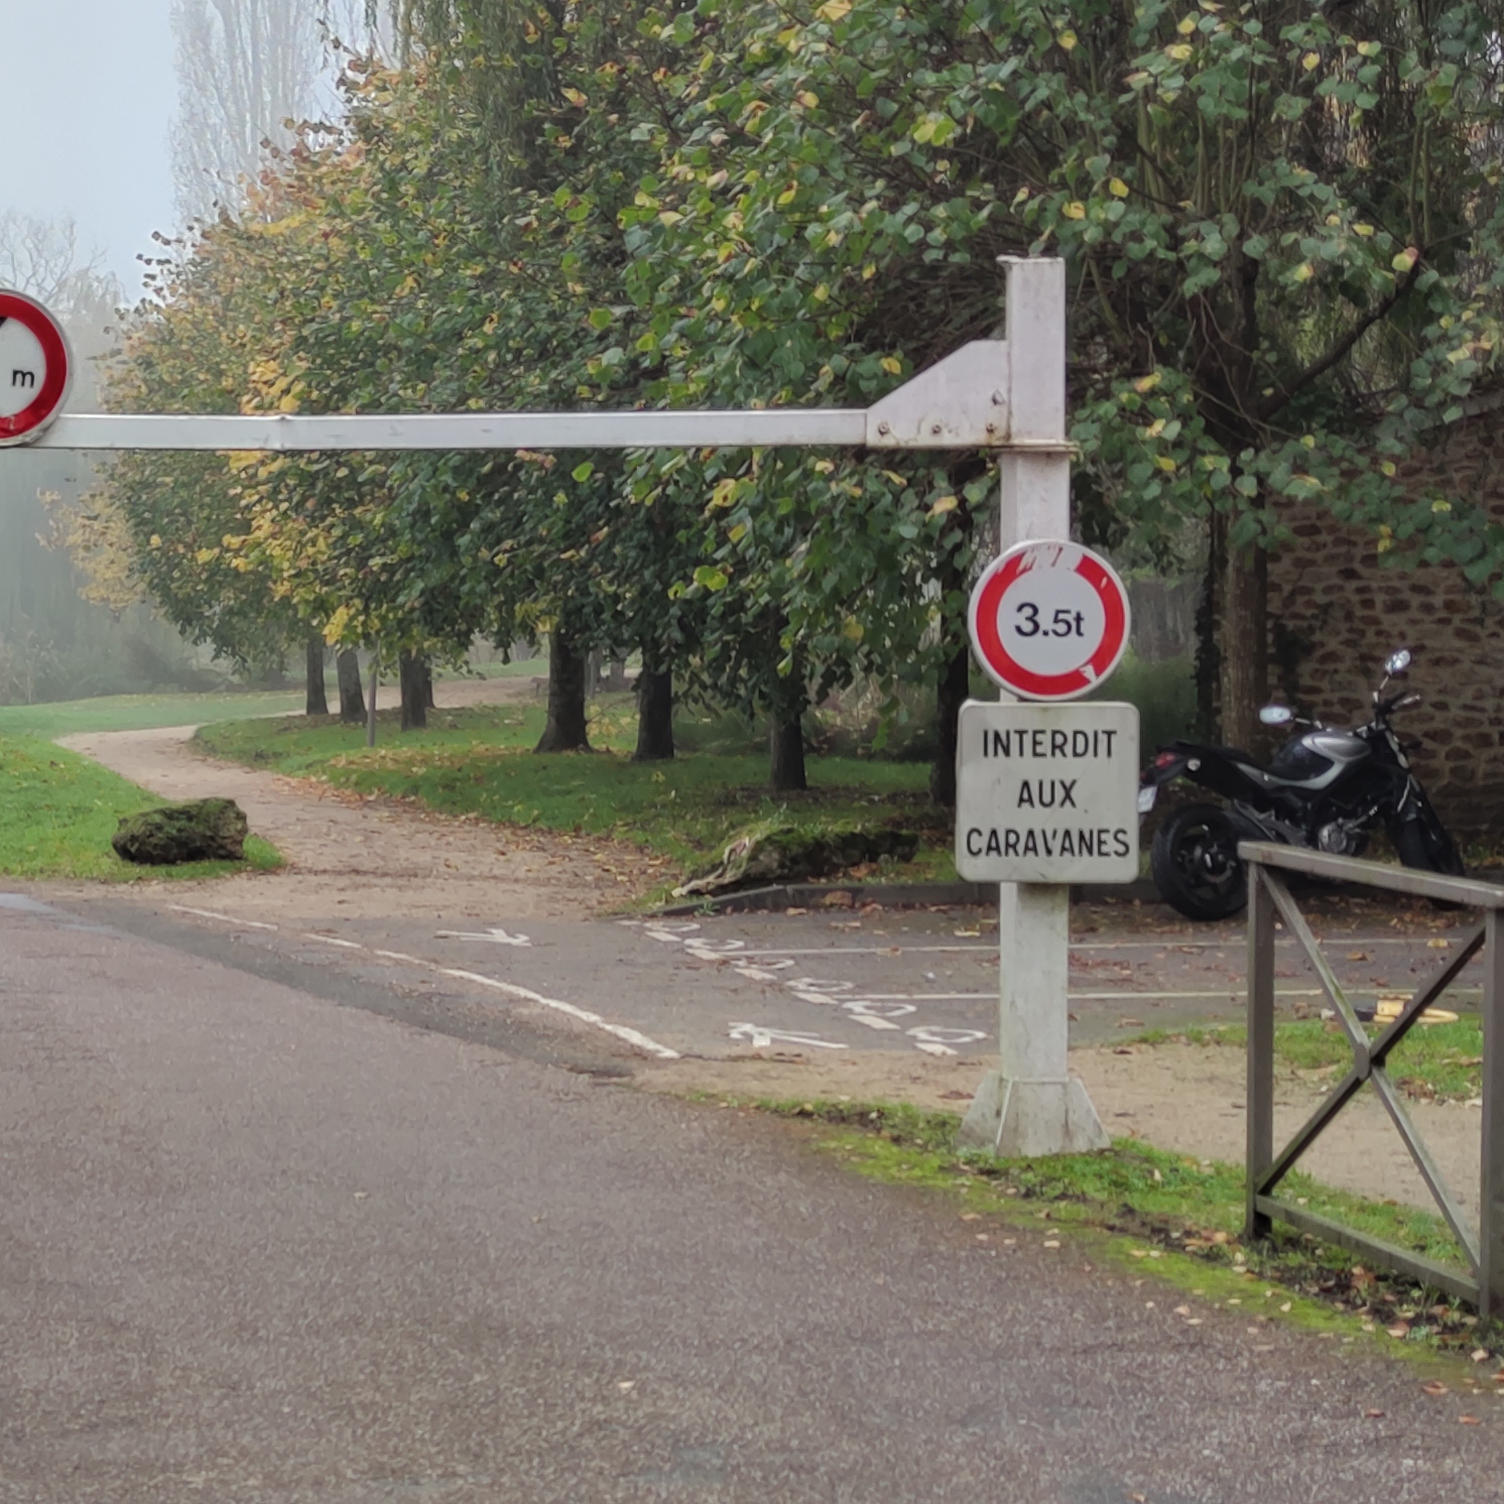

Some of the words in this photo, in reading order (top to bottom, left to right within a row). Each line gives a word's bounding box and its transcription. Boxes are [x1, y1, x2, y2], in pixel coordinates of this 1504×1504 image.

[11, 369, 35, 388] m
[1014, 602, 1085, 638] 3.5t
[982, 729, 1118, 759] INTERDIT
[1017, 779, 1078, 808] AUX
[966, 827, 1130, 859] CARAVANES
